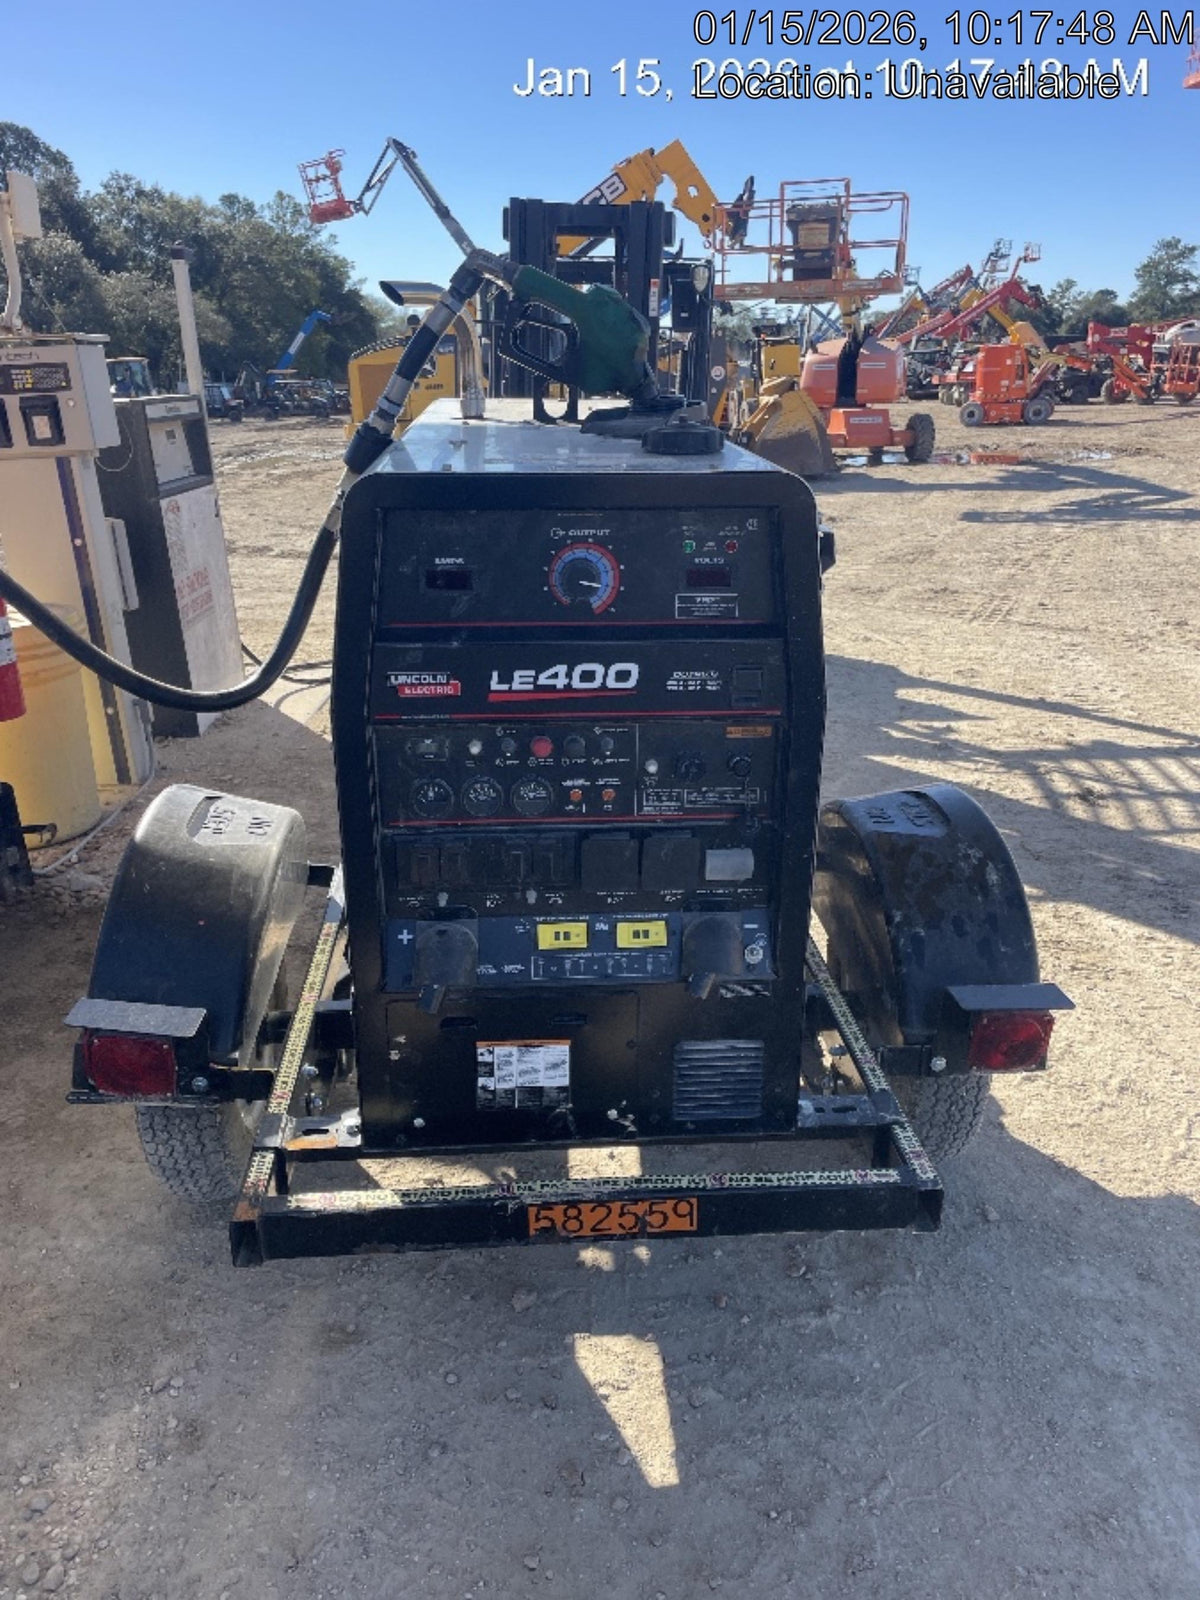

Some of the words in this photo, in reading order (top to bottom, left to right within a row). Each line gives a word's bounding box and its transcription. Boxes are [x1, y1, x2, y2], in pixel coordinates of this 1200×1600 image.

[568, 529, 611, 537] OUTPUT
[390, 674, 447, 684] LINCOLN
[490, 662, 640, 691] LE400
[404, 685, 454, 695] ELECTRIC
[534, 1199, 695, 1234] 582559
